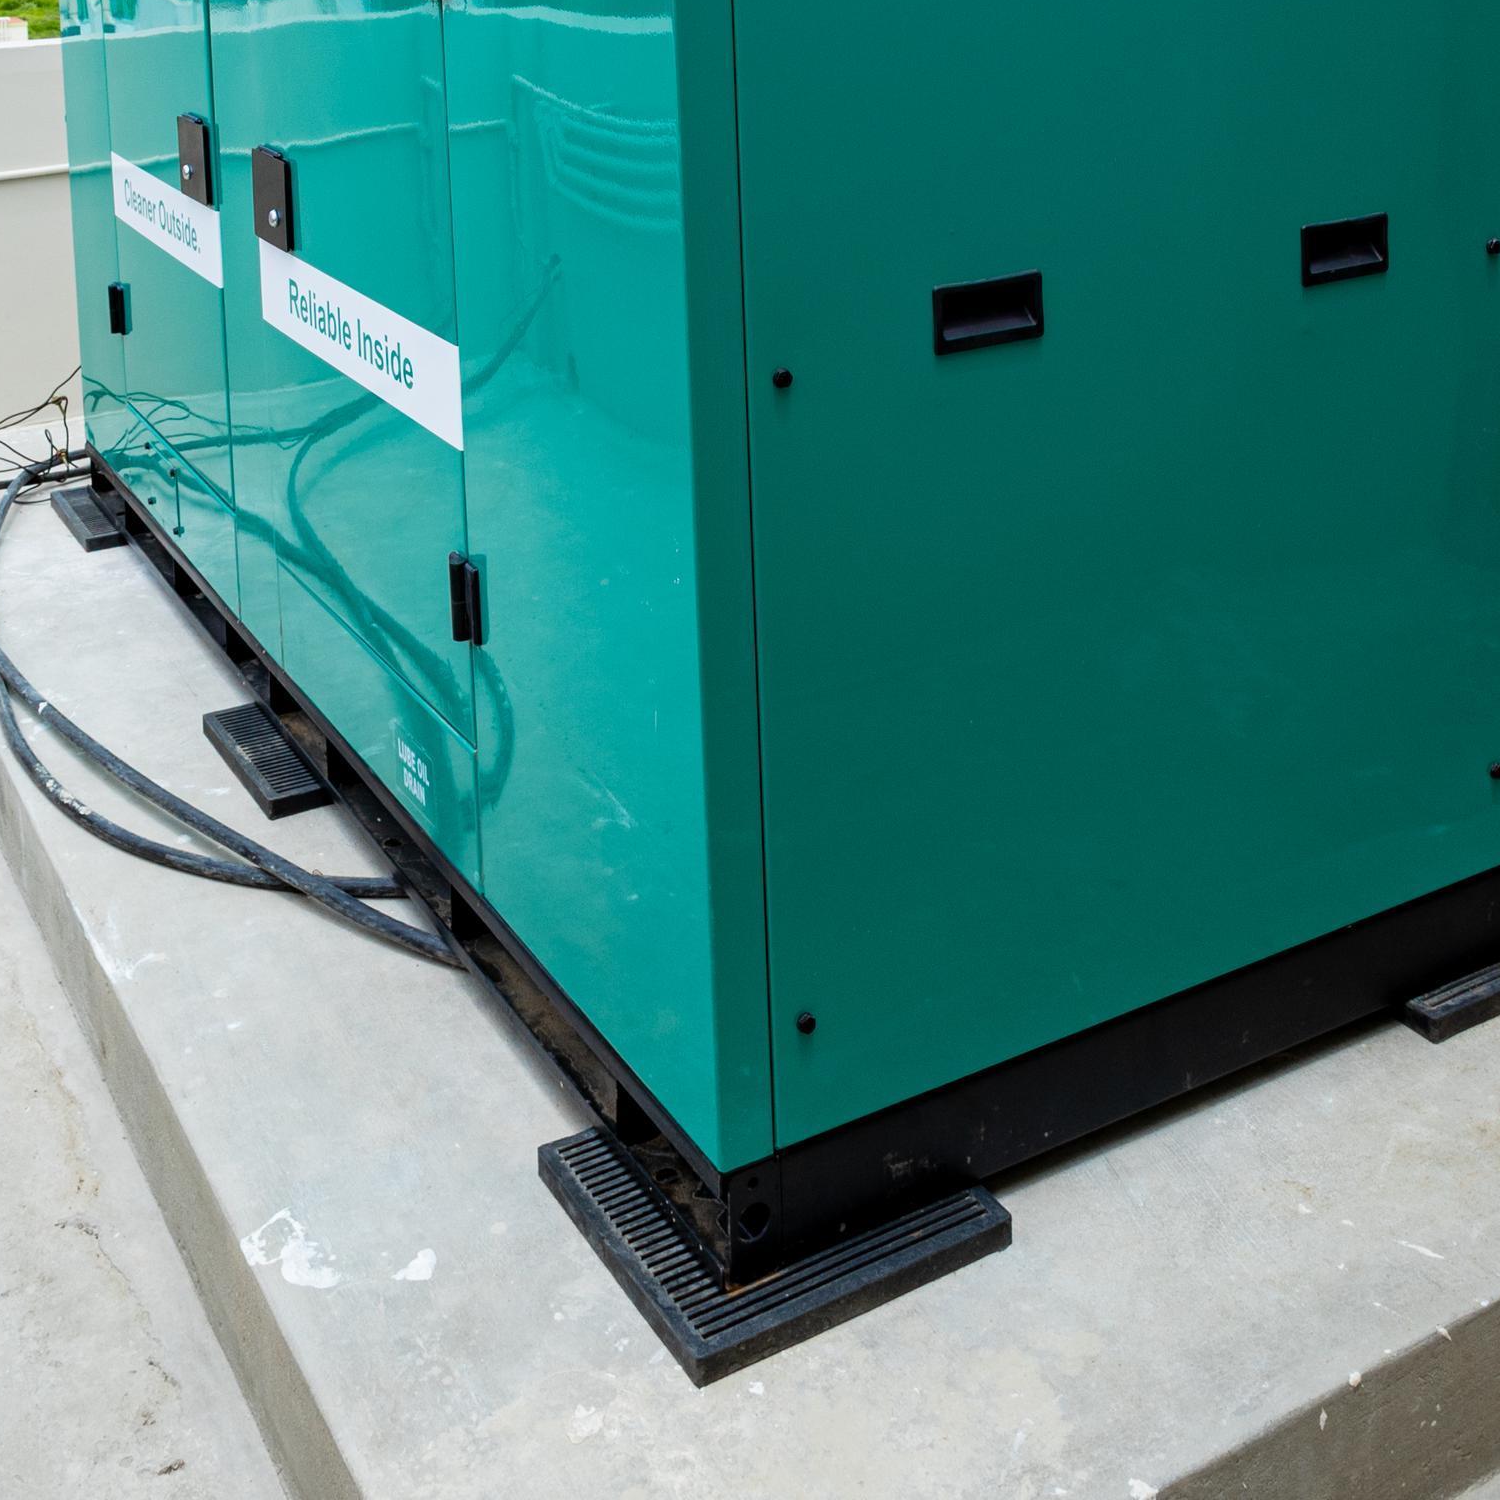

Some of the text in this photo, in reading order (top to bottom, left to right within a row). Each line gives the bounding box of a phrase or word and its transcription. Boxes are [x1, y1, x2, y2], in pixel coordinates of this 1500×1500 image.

[123, 178, 202, 255] Cleaner Outside.
[288, 277, 414, 390] Reliable Inside
[397, 736, 430, 787] LUBE OIL
[403, 766, 426, 807] DRAIN
